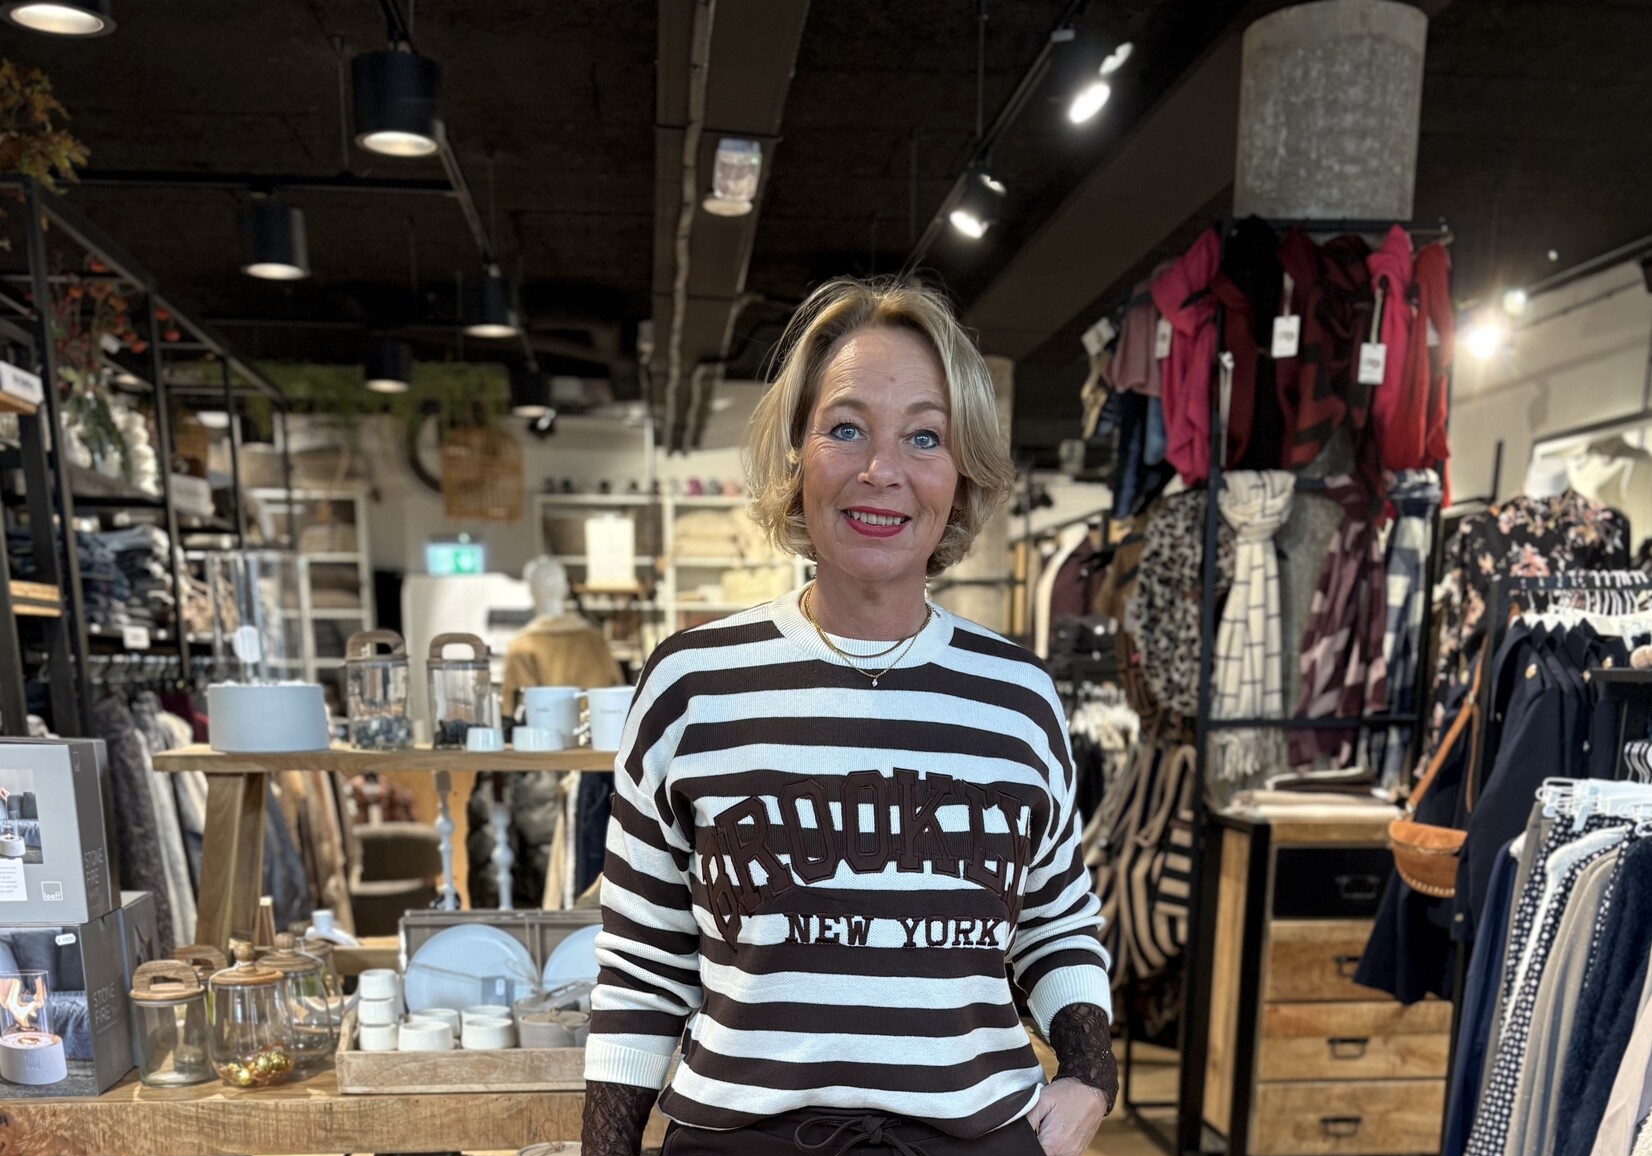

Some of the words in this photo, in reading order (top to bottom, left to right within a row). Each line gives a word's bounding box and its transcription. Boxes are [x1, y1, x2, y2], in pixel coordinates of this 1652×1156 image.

[783, 912, 875, 946] NEW
[897, 915, 1004, 948] YORK
[93, 982, 116, 1008] STONE
[95, 1004, 112, 1026] FIRE
